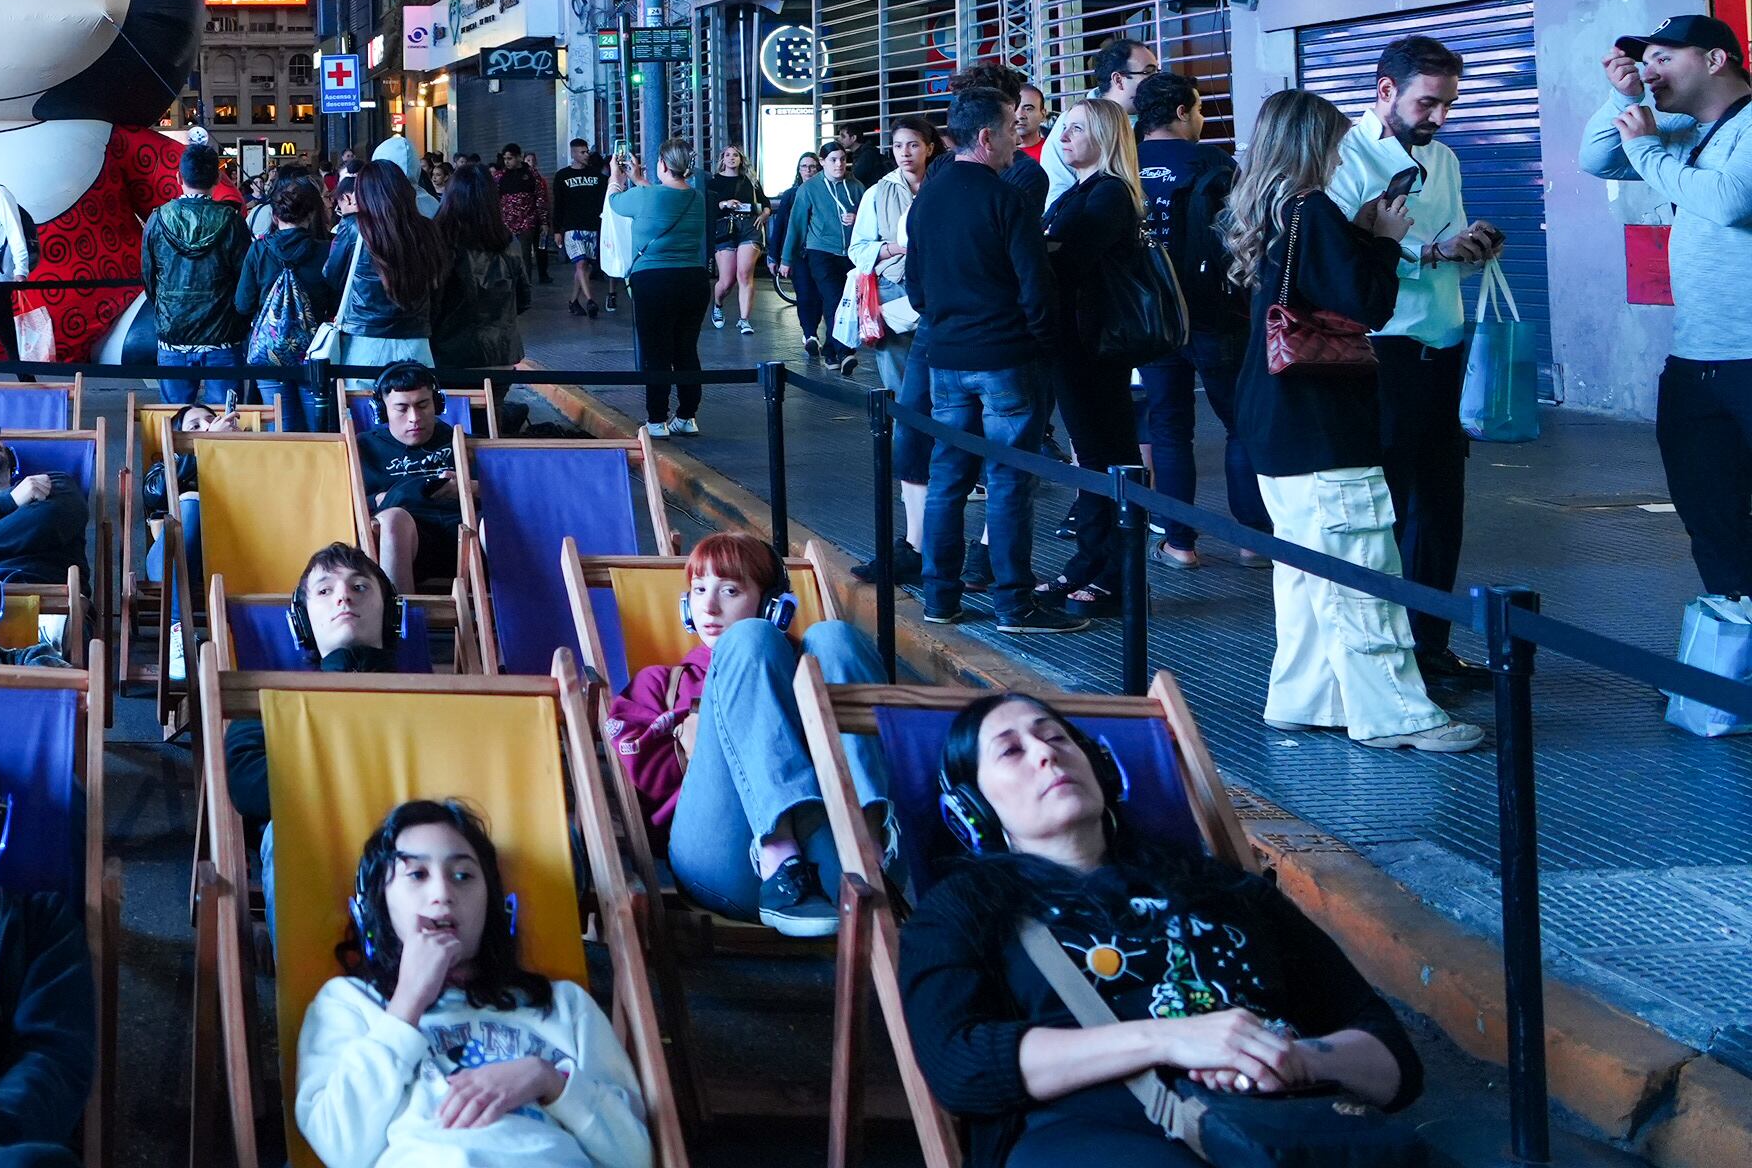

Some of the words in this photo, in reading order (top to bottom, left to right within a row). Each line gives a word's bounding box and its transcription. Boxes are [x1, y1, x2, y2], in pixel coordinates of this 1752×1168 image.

[602, 35, 614, 44] 24
[603, 50, 614, 59] 26
[564, 176, 599, 186] VINTAGE
